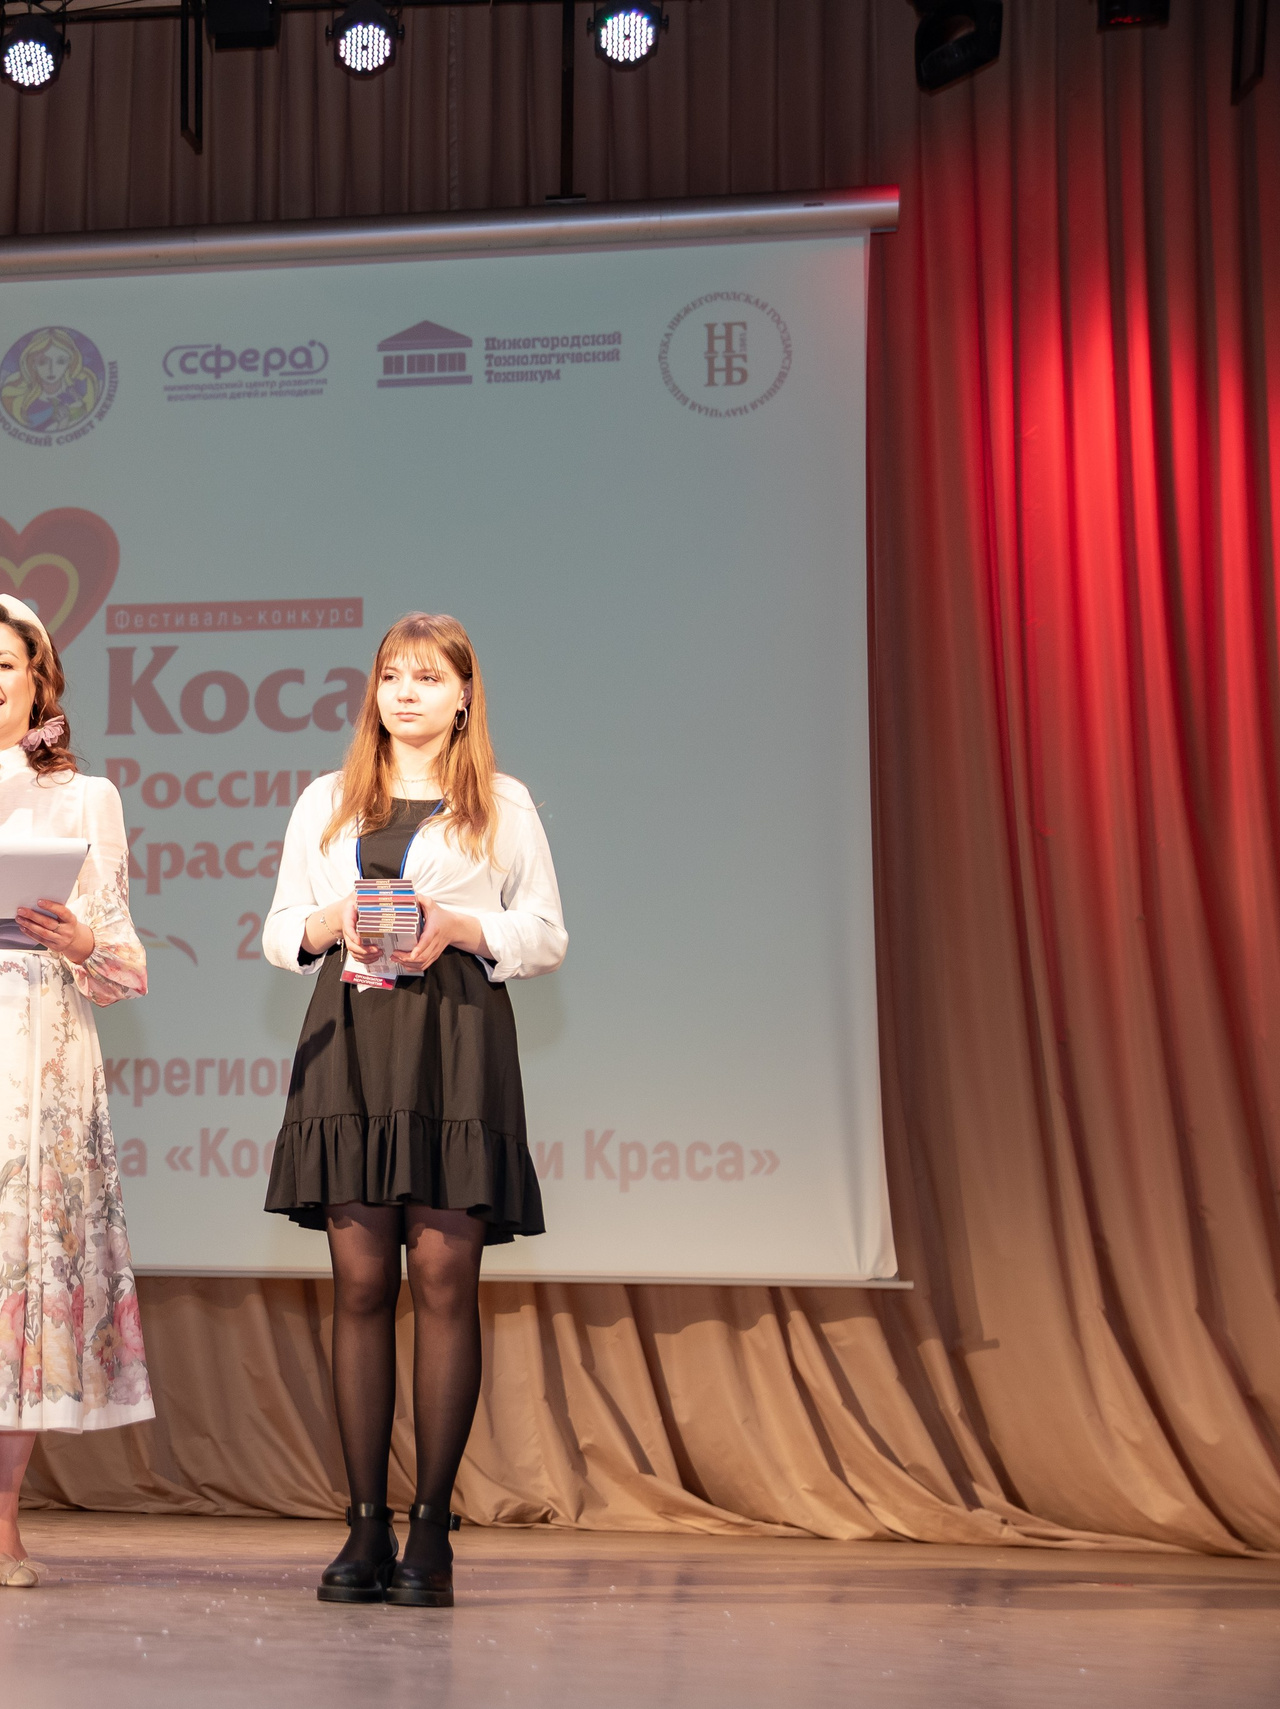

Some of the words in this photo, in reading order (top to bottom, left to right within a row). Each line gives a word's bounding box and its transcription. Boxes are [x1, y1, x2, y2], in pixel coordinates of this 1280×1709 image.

[484, 331, 622, 351] Нижегородский
[178, 341, 317, 379] сфера
[484, 348, 621, 367] Технологический
[484, 368, 561, 384] Техникум
[55, 422, 95, 446] СОВЕТ
[114, 607, 355, 631] Фестиваль-конкурс
[104, 645, 369, 736] Коса
[584, 1129, 781, 1193] Краса»
